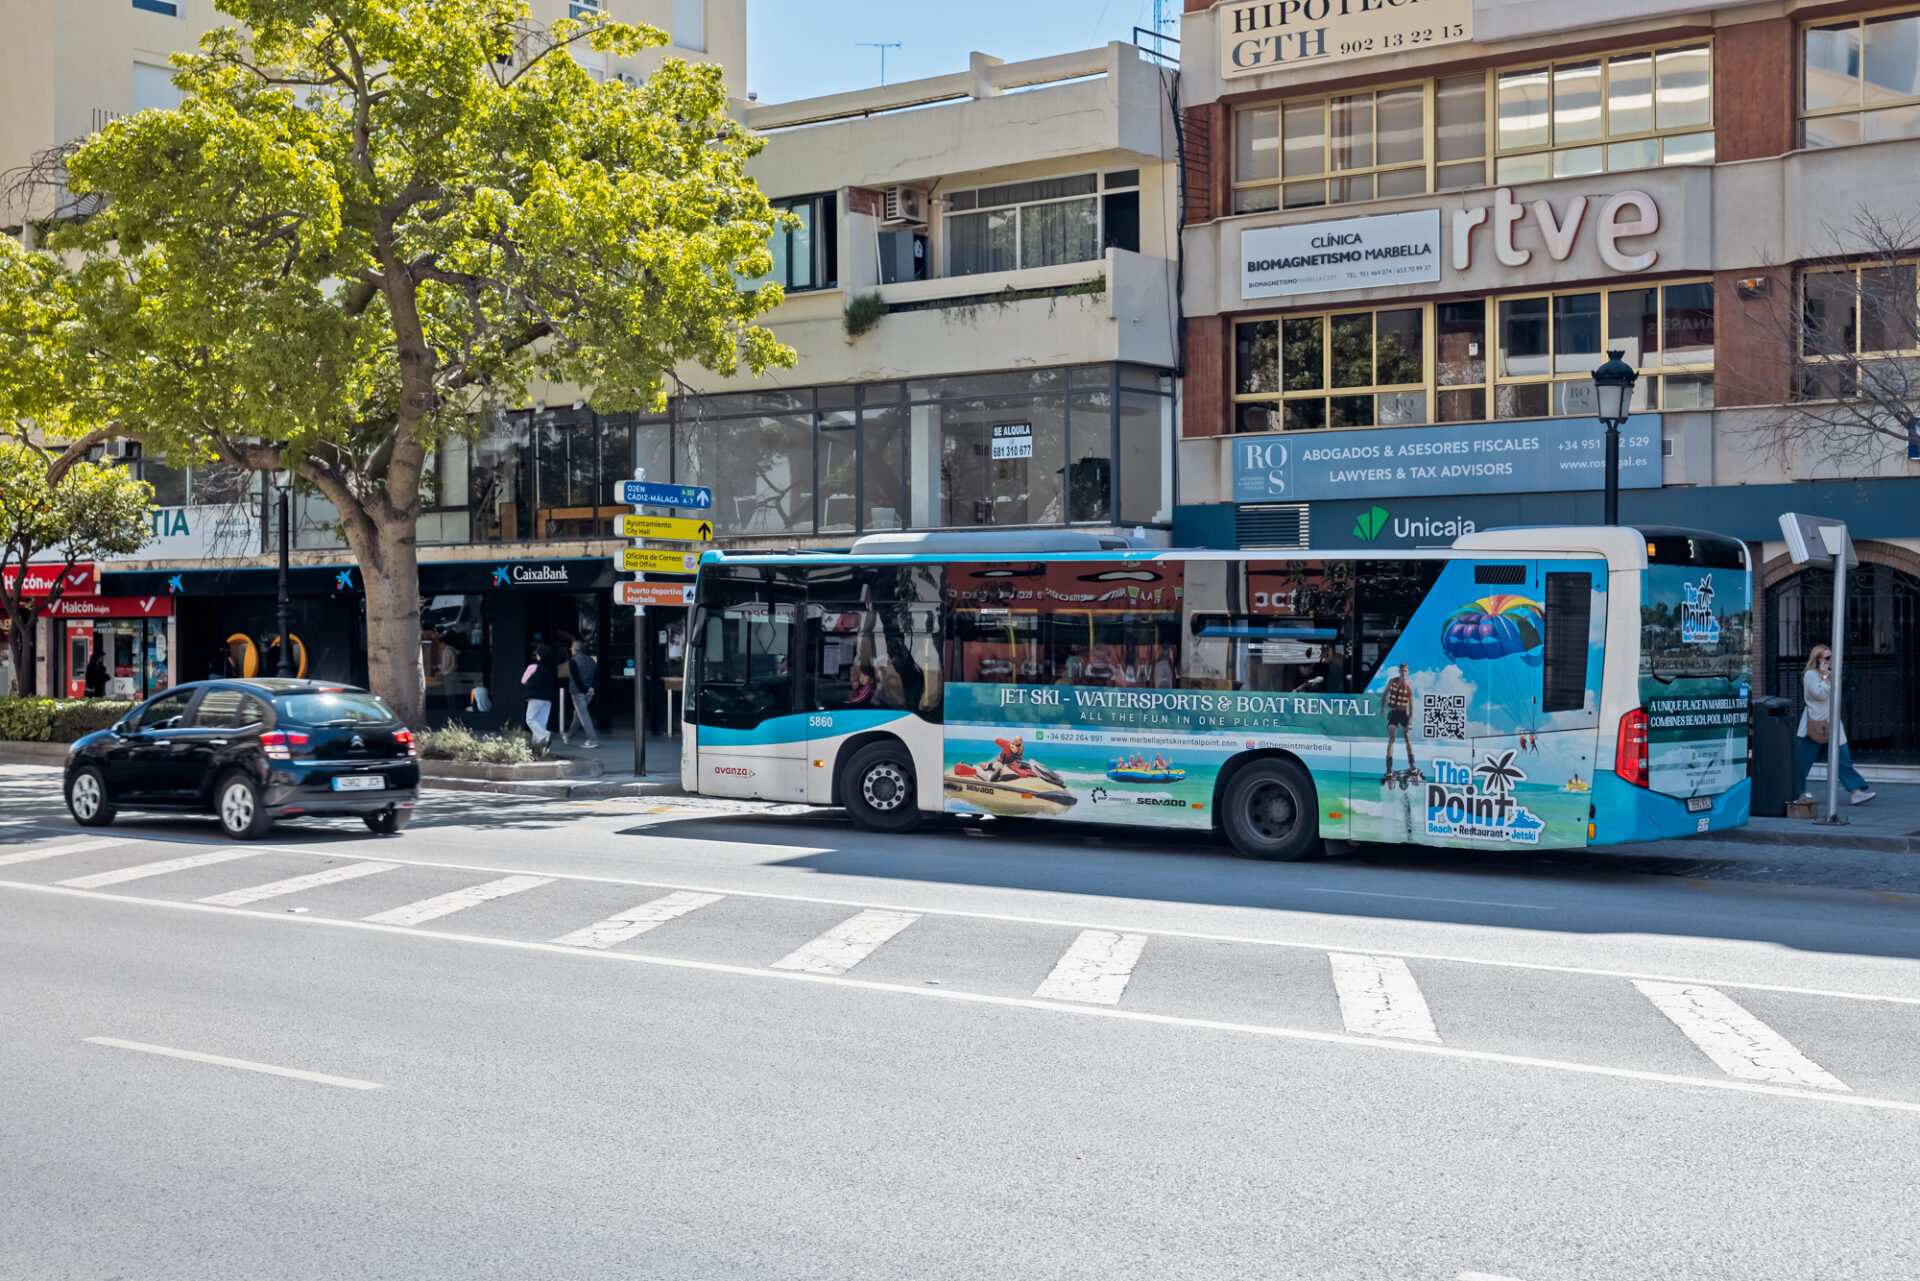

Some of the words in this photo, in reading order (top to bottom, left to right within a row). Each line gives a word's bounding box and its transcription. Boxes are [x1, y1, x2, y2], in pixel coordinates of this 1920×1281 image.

[1232, 0, 1428, 34] HIPOT
[1232, 27, 1330, 68] GTH
[1341, 38, 1373, 55] 902
[1383, 34, 1403, 48] 13
[1411, 29, 1433, 43] 22
[1441, 24, 1463, 38] 15
[1452, 187, 1660, 272] rtve
[1311, 232, 1362, 249] CLÍNICA
[1247, 250, 1362, 273] BIOMAGNETISMO
[1364, 243, 1431, 261] MARBELLA
[1570, 387, 1590, 398] RO
[994, 426, 1002, 437] SE
[1003, 424, 1030, 436] ALQUILA
[993, 446, 1005, 457] 681
[1006, 445, 1018, 457] 310
[1019, 444, 1031, 456] 677
[1245, 443, 1287, 469] RO
[1302, 445, 1380, 462] ABOGADOS
[1383, 444, 1394, 457] &
[1398, 441, 1469, 456] ASESORES
[1474, 437, 1539, 453] FISCALES
[1558, 440, 1578, 451] +34
[1581, 438, 1600, 449] 951
[1629, 436, 1650, 447] 529
[1560, 456, 1647, 470] www.rosgal.es
[1329, 468, 1392, 483] LAWYERS
[1396, 467, 1406, 479] &
[1409, 465, 1437, 479] TAX
[1440, 462, 1512, 478] ADVISORS
[627, 484, 645, 492] OJÉN
[1269, 469, 1285, 494] S
[627, 493, 679, 503] CÁDIZ-MÁLAGA
[152, 509, 190, 537] TIA
[627, 519, 671, 529] Ayuntamiento
[1394, 516, 1475, 538] Unicaja
[626, 552, 648, 560] Oficina
[659, 554, 682, 562] Correos
[1688, 539, 1695, 558] 3
[513, 565, 568, 580] CaixaBank
[5, 573, 43, 590] Hcón
[627, 595, 656, 603] Marbella
[651, 588, 682, 596] deportivo
[62, 601, 94, 613] Halcón
[1683, 603, 1711, 632] Point
[1000, 688, 1026, 707] JET
[1030, 689, 1060, 705] SKI
[1075, 690, 1213, 711] WATERSPORTS
[1217, 696, 1232, 711] &
[1236, 696, 1289, 713] BOAT
[1293, 698, 1376, 716] RENTAL
[1650, 701, 1656, 711] A
[1657, 700, 1681, 713] UNIQUE
[1682, 699, 1701, 711] PLACE
[1708, 698, 1735, 709] MARBELLA
[809, 716, 832, 728] 5860
[1081, 711, 1102, 721] ALL
[1111, 712, 1135, 722] THE
[1143, 713, 1168, 724] FUN
[1177, 715, 1190, 725] IN
[1199, 716, 1225, 726] ONE
[1234, 717, 1279, 727] PLACE
[1650, 715, 1685, 727] COMBINES
[1707, 713, 1721, 725] POOL
[1047, 733, 1059, 741] +34
[1061, 733, 1074, 741] 622
[1075, 734, 1088, 742] 264
[1110, 736, 1237, 748] www.marbellajetskirentalpoint.com
[1258, 741, 1332, 751] @thepointmarbella
[714, 765, 748, 776] avanza
[1435, 760, 1469, 785] The
[1428, 785, 1514, 827] Point
[1428, 823, 1452, 834] Beach
[1459, 825, 1503, 838] Restaurant
[1511, 831, 1536, 842] Jetski
